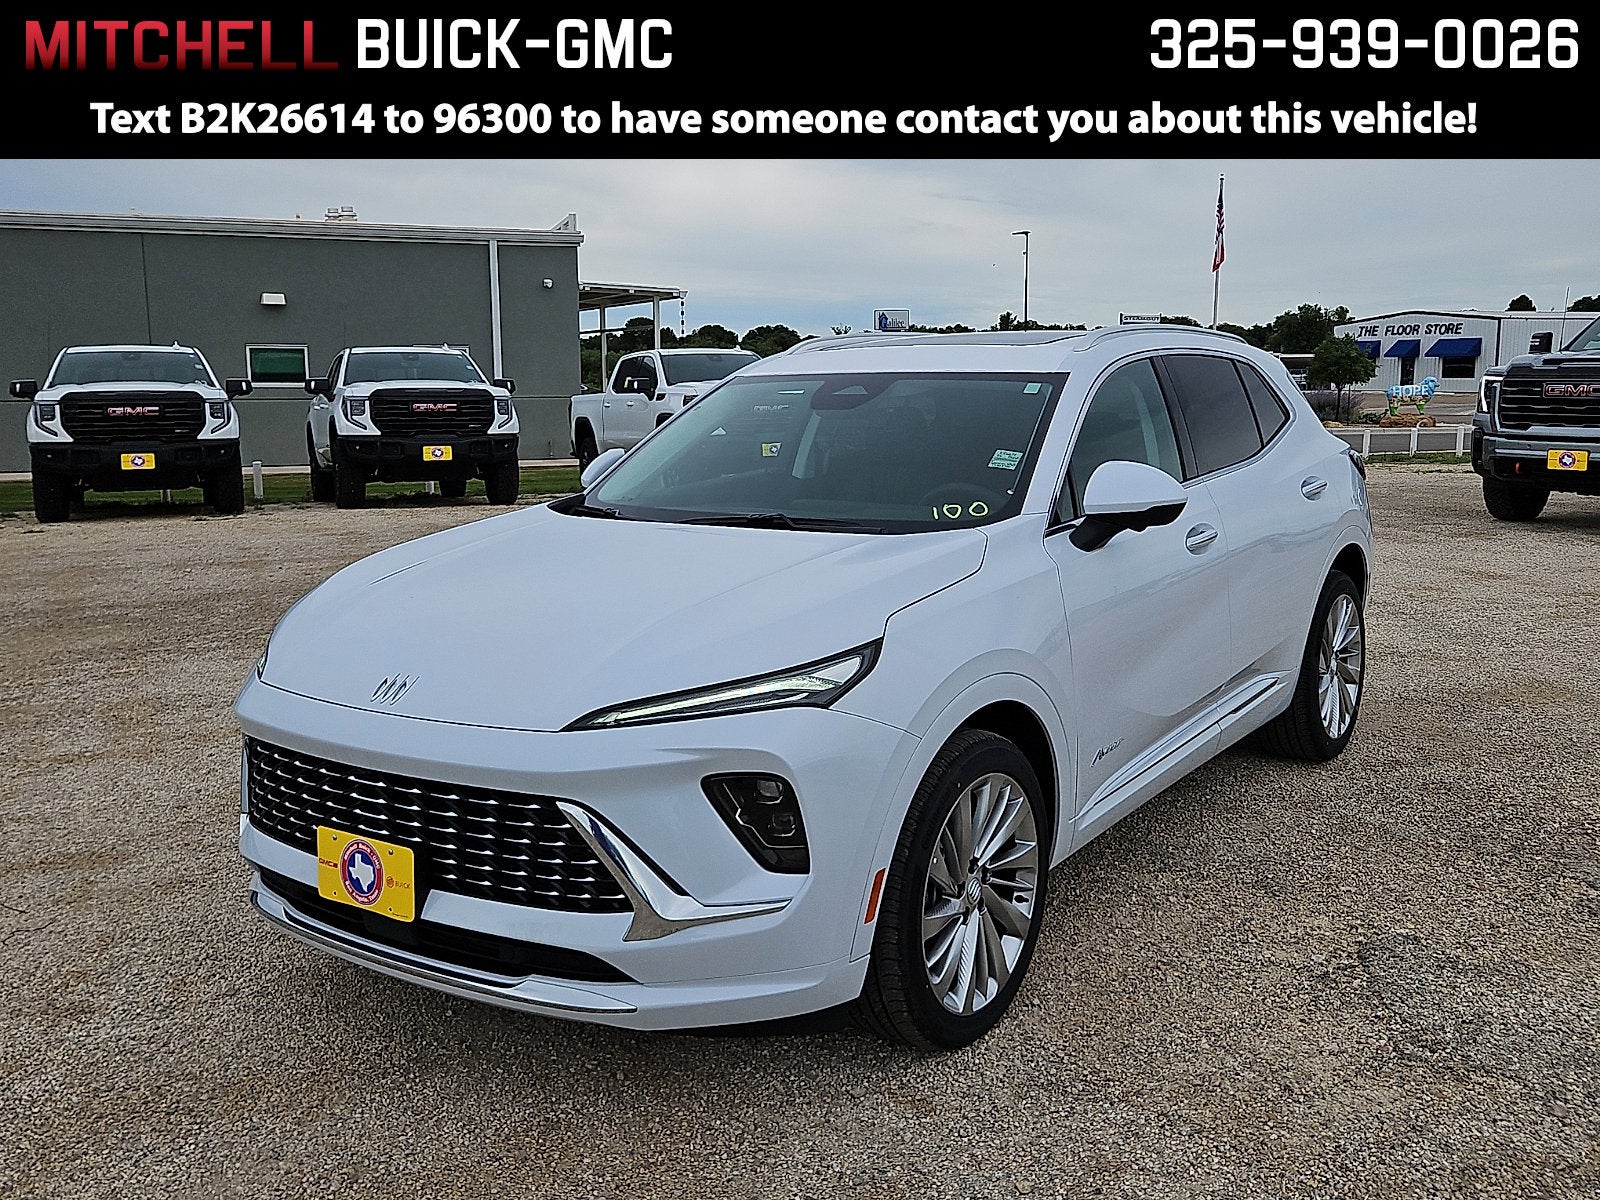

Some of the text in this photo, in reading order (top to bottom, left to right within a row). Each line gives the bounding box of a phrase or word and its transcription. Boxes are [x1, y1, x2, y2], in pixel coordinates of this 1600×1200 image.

[1358, 322, 1464, 337] THE FLOOR STORE
[1392, 385, 1429, 397] HOPE
[1546, 384, 1600, 396] GMC
[107, 406, 160, 416] GMC
[932, 501, 989, 520] 100
